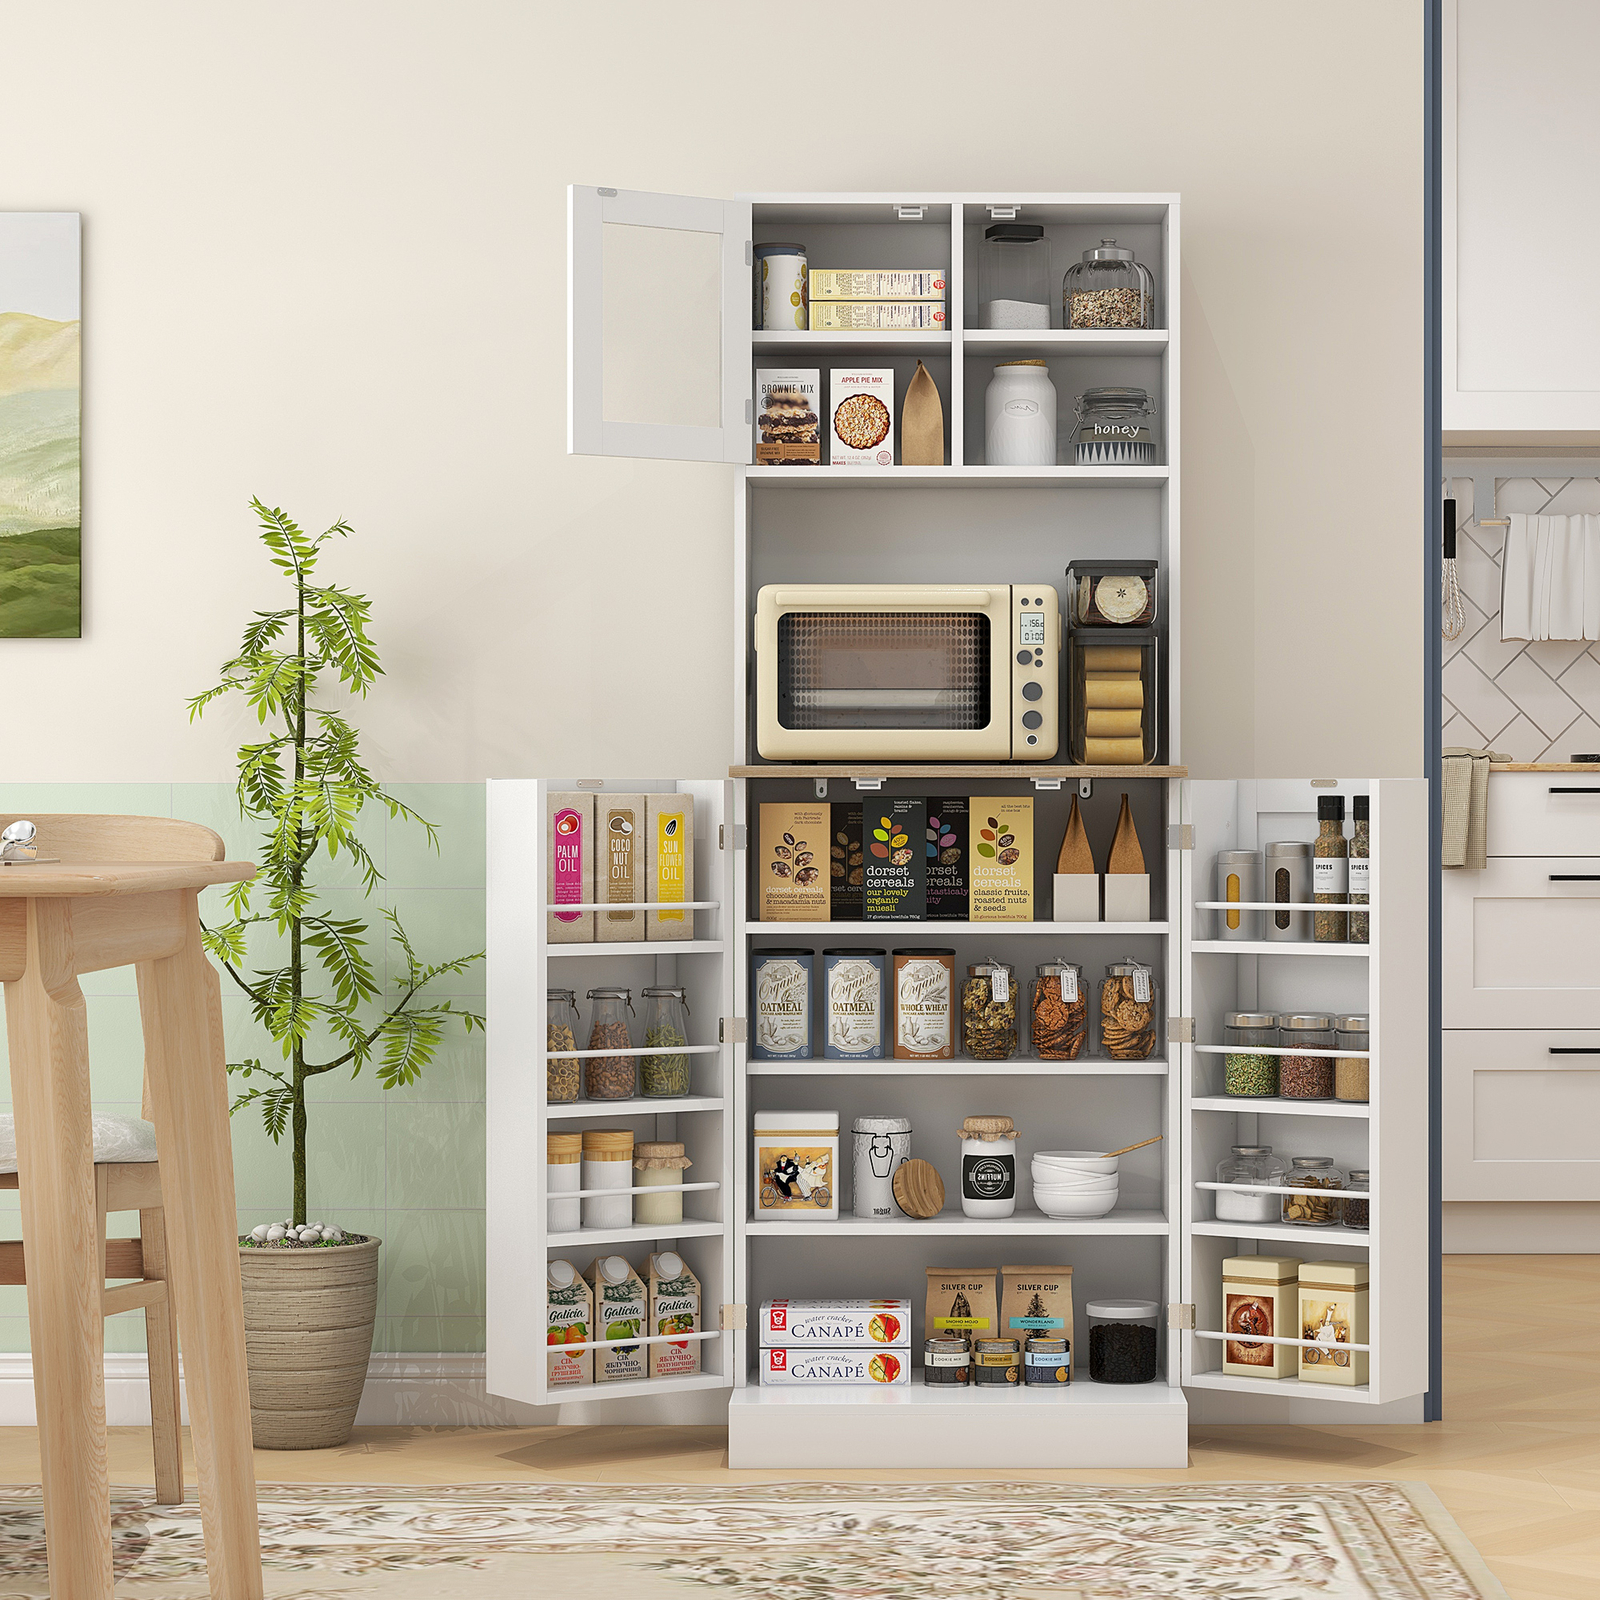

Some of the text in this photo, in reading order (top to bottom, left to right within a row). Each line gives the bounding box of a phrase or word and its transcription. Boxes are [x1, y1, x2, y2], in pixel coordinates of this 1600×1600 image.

[762, 384, 814, 394] BROWNIE MIX
[1094, 423, 1140, 438] honey
[611, 838, 630, 852] COCO
[663, 840, 678, 853] SUN
[557, 845, 579, 858] PALM
[614, 852, 628, 865] NUT
[659, 854, 682, 867] FLOWER
[558, 859, 577, 872] OIL
[866, 866, 910, 876] dorset
[926, 865, 958, 875] orset
[973, 866, 1016, 876] dorset
[612, 866, 630, 879] OIL
[662, 867, 680, 880] OIL
[866, 877, 915, 888] cereals
[973, 877, 1021, 888] cereals
[884, 888, 909, 898] lovely
[866, 896, 899, 906] organic
[866, 904, 896, 912] muesli
[760, 1002, 803, 1012] OATMEAL
[832, 1002, 875, 1012] OATMEAL
[900, 1004, 948, 1012] WHOLE WHEAT
[604, 1304, 642, 1320] Galicia
[658, 1299, 695, 1315] Galicia
[549, 1308, 586, 1324] Galicia
[805, 1314, 853, 1324] water cracker
[791, 1322, 865, 1338] CANAPÉ
[805, 1354, 853, 1364] water cracker
[791, 1362, 865, 1378] CANAPÉ
